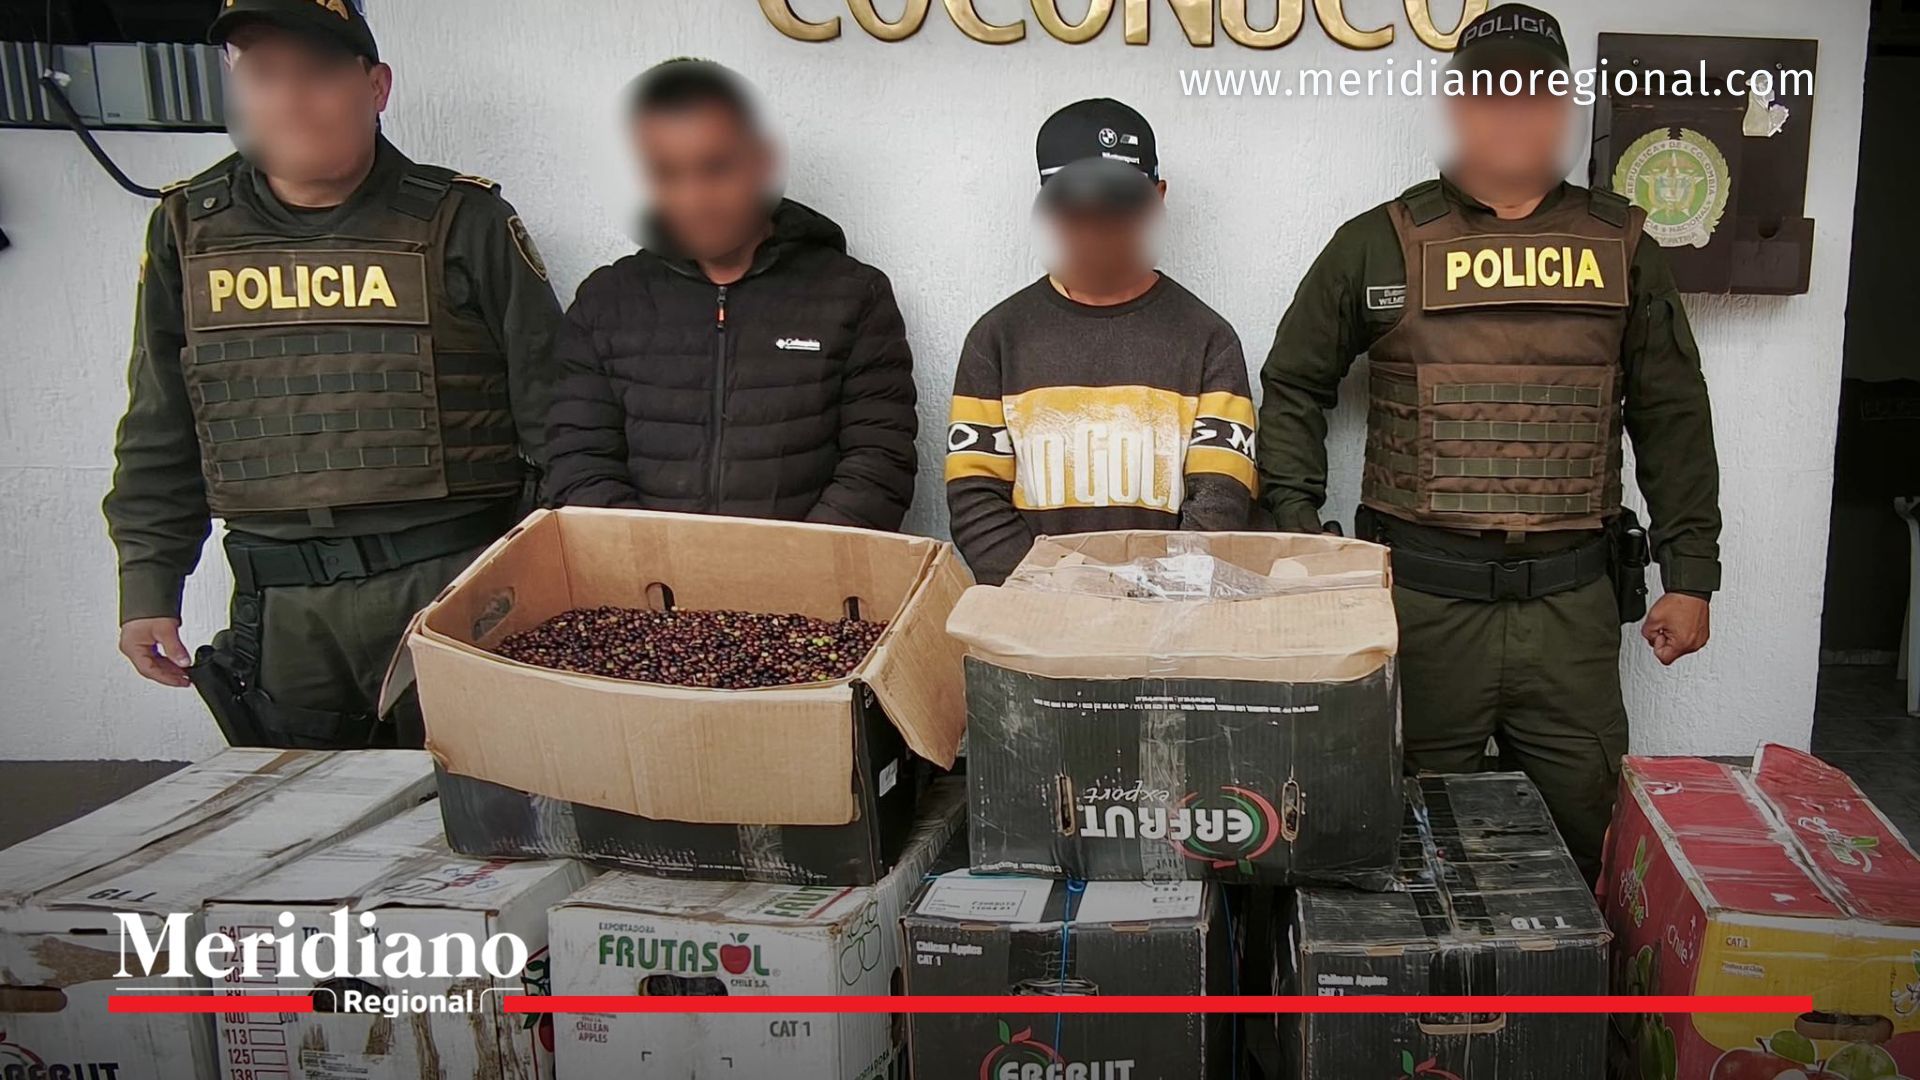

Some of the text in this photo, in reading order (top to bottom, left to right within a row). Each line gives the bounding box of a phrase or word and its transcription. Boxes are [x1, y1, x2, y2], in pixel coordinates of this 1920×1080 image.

[1446, 247, 1605, 291] POLICIA
[209, 264, 397, 313] POLICIA
[1084, 779, 1169, 804] export
[1080, 804, 1253, 843] ERFRUT
[916, 941, 983, 956] Chilean Apples
[1667, 923, 1689, 964] Chile
[1726, 937, 1742, 948] CAT
[917, 954, 942, 966] CAT 1
[576, 1021, 610, 1032] CHILEAN
[769, 1020, 811, 1037] CAT 1
[226, 1029, 248, 1044] 113
[578, 1032, 608, 1043] APPLES
[228, 1049, 250, 1064] 125
